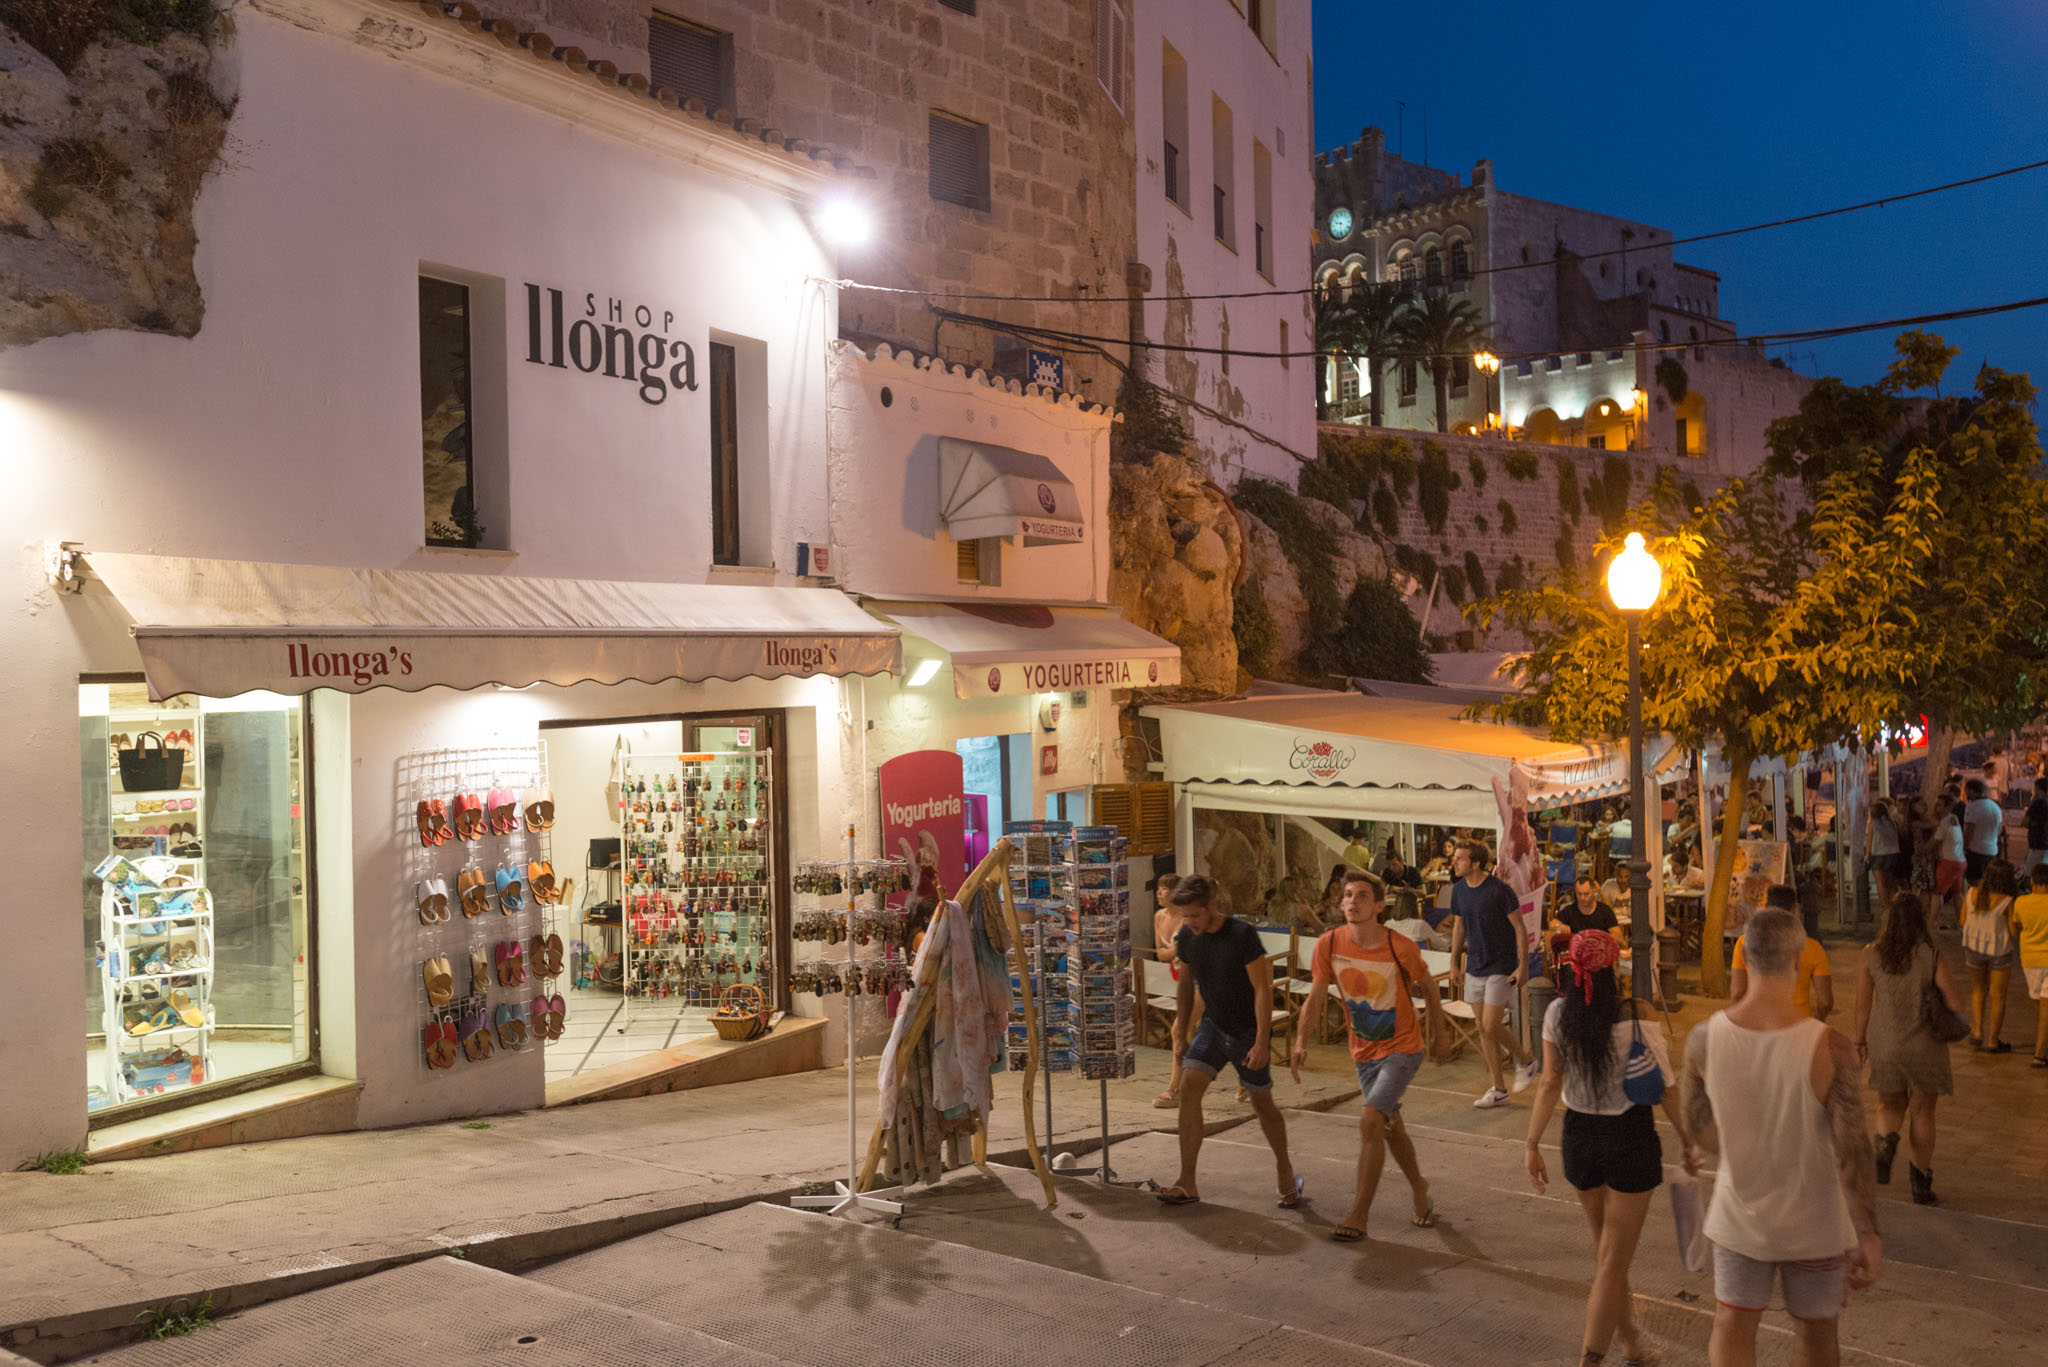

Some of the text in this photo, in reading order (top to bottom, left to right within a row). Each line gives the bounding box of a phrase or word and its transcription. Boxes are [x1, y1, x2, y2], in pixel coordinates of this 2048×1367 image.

[585, 292, 674, 333] SHOP
[524, 282, 699, 405] llonga
[1031, 522, 1076, 537] YOGURTERIA
[287, 643, 413, 686] llonga's
[765, 641, 837, 673] llonga's
[1023, 661, 1131, 689] YOGURTERIA
[1289, 735, 1357, 770] Corallo
[1563, 757, 1612, 786] PIZZERIA
[886, 793, 962, 828] Yogurteria
